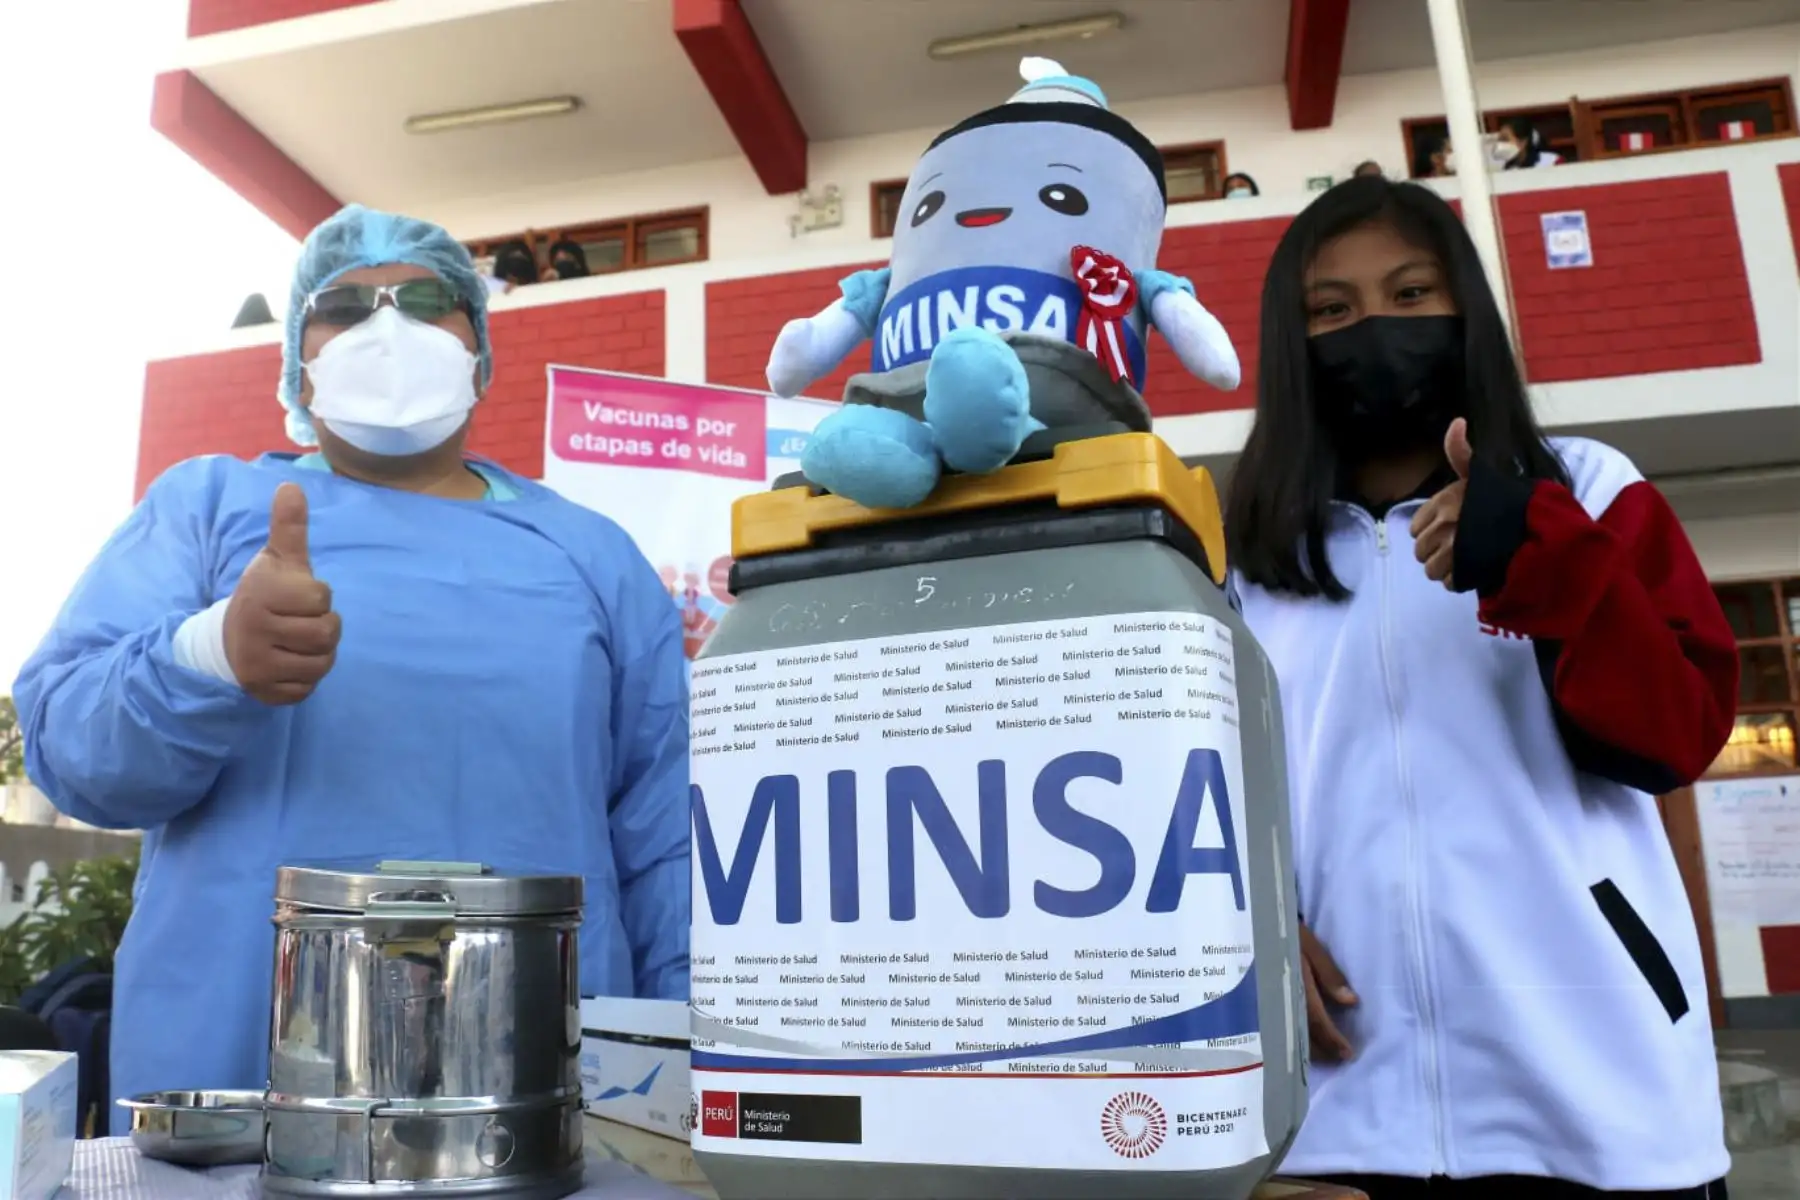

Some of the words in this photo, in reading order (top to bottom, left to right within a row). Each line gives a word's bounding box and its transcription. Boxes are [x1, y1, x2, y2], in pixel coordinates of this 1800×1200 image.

[881, 285, 1067, 371] MINSA
[583, 400, 690, 431] Vacunas
[696, 417, 737, 437] por
[569, 432, 654, 457] etapas
[661, 438, 691, 459] de
[698, 444, 747, 468] vida
[915, 576, 937, 604] 5
[1113, 621, 1166, 633] Ministerio
[1168, 621, 1180, 631] de
[1182, 621, 1205, 633] Salud
[992, 632, 1043, 644] Ministerio
[1044, 629, 1058, 640] de
[1059, 626, 1088, 638] Salud
[879, 643, 927, 655] Ministerio
[928, 641, 941, 650] de
[942, 638, 969, 649] Salud
[1062, 648, 1114, 660] Ministerio
[1116, 646, 1130, 656] de
[1131, 644, 1161, 655] Salud
[776, 655, 819, 666] Ministerio
[819, 652, 832, 662] de
[833, 649, 858, 660] Salud
[944, 658, 994, 671] Ministerio
[996, 657, 1009, 666] de
[1010, 654, 1038, 665] Salud
[722, 664, 733, 674] de
[734, 661, 757, 672] Salud
[833, 671, 880, 682] Ministerio
[881, 668, 893, 678] de
[894, 665, 921, 676] Salud
[1114, 665, 1168, 676] Ministerio
[1169, 664, 1183, 674] de
[1184, 664, 1207, 676] Salud
[995, 674, 1045, 686] Ministerio
[1047, 673, 1061, 682] de
[1062, 669, 1091, 680] Salud
[734, 681, 776, 693] Ministerio
[776, 679, 788, 688] de
[789, 676, 813, 687] Salud
[881, 684, 930, 696] Ministerio
[931, 682, 944, 692] de
[945, 679, 972, 691] Salud
[775, 696, 819, 706] Ministerio
[820, 693, 832, 702] de
[833, 690, 859, 701] Salud
[1063, 692, 1116, 704] Ministerio
[1117, 691, 1131, 700] de
[1133, 687, 1163, 699] Salud
[722, 703, 732, 712] de
[733, 700, 756, 711] Salud
[944, 702, 994, 713] Ministerio
[996, 700, 1009, 710] de
[1010, 697, 1038, 708] Salud
[834, 711, 881, 723] Ministerio
[881, 709, 894, 719] de
[895, 707, 922, 718] Salud
[1117, 709, 1172, 720] Ministerio
[1173, 708, 1186, 718] de
[1188, 708, 1211, 719] Salud
[733, 720, 775, 732] Ministerio
[776, 719, 788, 728] de
[788, 716, 813, 727] Salud
[995, 718, 1047, 729] Ministerio
[1048, 715, 1062, 725] de
[1063, 713, 1092, 724] Salud
[881, 727, 929, 738] Ministerio
[930, 725, 943, 735] de
[945, 722, 972, 733] Salud
[775, 736, 819, 746] Ministerio
[821, 733, 833, 743] de
[834, 731, 860, 742] Salud
[722, 743, 732, 752] de
[733, 740, 756, 751] Salud
[690, 748, 1246, 925] MINSA
[839, 953, 887, 964] Ministerio
[888, 953, 901, 963] de
[902, 952, 929, 963] Salud
[952, 951, 1003, 962] Ministerio
[1004, 950, 1018, 961] de
[1020, 949, 1048, 960] Salud
[1073, 948, 1128, 959] Ministerio
[1130, 947, 1144, 958] de
[1146, 946, 1177, 957] Salud
[734, 955, 778, 965] Ministerio
[779, 954, 792, 964] de
[792, 954, 818, 964] Salud
[779, 974, 825, 984] Ministerio
[826, 973, 838, 984] de
[839, 973, 866, 983] Salud
[888, 973, 937, 983] Ministerio
[938, 972, 951, 982] de
[953, 971, 981, 982] Salud
[1004, 971, 1057, 981] Ministerio
[1058, 970, 1072, 981] de
[1074, 969, 1103, 980] Salud
[1129, 968, 1185, 979] Ministerio
[1187, 967, 1200, 977] de
[1202, 965, 1225, 976] Salud
[722, 974, 733, 984] de
[734, 974, 759, 984] Salud
[735, 996, 779, 1006] Ministerio
[780, 997, 792, 1006] de
[793, 997, 818, 1007] Salud
[840, 997, 888, 1007] Ministerio
[889, 997, 902, 1007] de
[903, 996, 930, 1007] Salud
[955, 996, 1007, 1006] Ministerio
[1008, 995, 1022, 1006] de
[1023, 995, 1052, 1006] Salud
[1076, 994, 1131, 1004] Ministerio
[1133, 993, 1147, 1004] de
[1149, 992, 1180, 1003] Salud
[723, 1016, 733, 1025] de
[735, 1016, 759, 1025] Salud
[780, 1016, 825, 1026] Ministerio
[826, 1016, 839, 1027] de
[840, 1017, 866, 1027] Salud
[890, 1017, 940, 1027] Ministerio
[941, 1016, 954, 1027] de
[955, 1017, 984, 1027] Salud
[1006, 1016, 1059, 1027] Ministerio
[1061, 1016, 1075, 1026] de
[1077, 1015, 1106, 1026] Salud
[841, 1041, 889, 1050] Ministerio
[890, 1041, 903, 1050] de
[904, 1041, 931, 1050] Salud
[955, 1041, 1006, 1051] Ministerio
[1007, 1062, 1060, 1072] Ministerio
[1062, 1062, 1076, 1072] de
[1077, 1062, 1107, 1072] Salud
[705, 1105, 734, 1121] PERÚ
[744, 1109, 790, 1121] Ministerio
[744, 1121, 755, 1132] de
[758, 1121, 783, 1133] Salud
[1178, 1124, 1210, 1136] PERÚ
[1214, 1123, 1234, 1134] 2021
